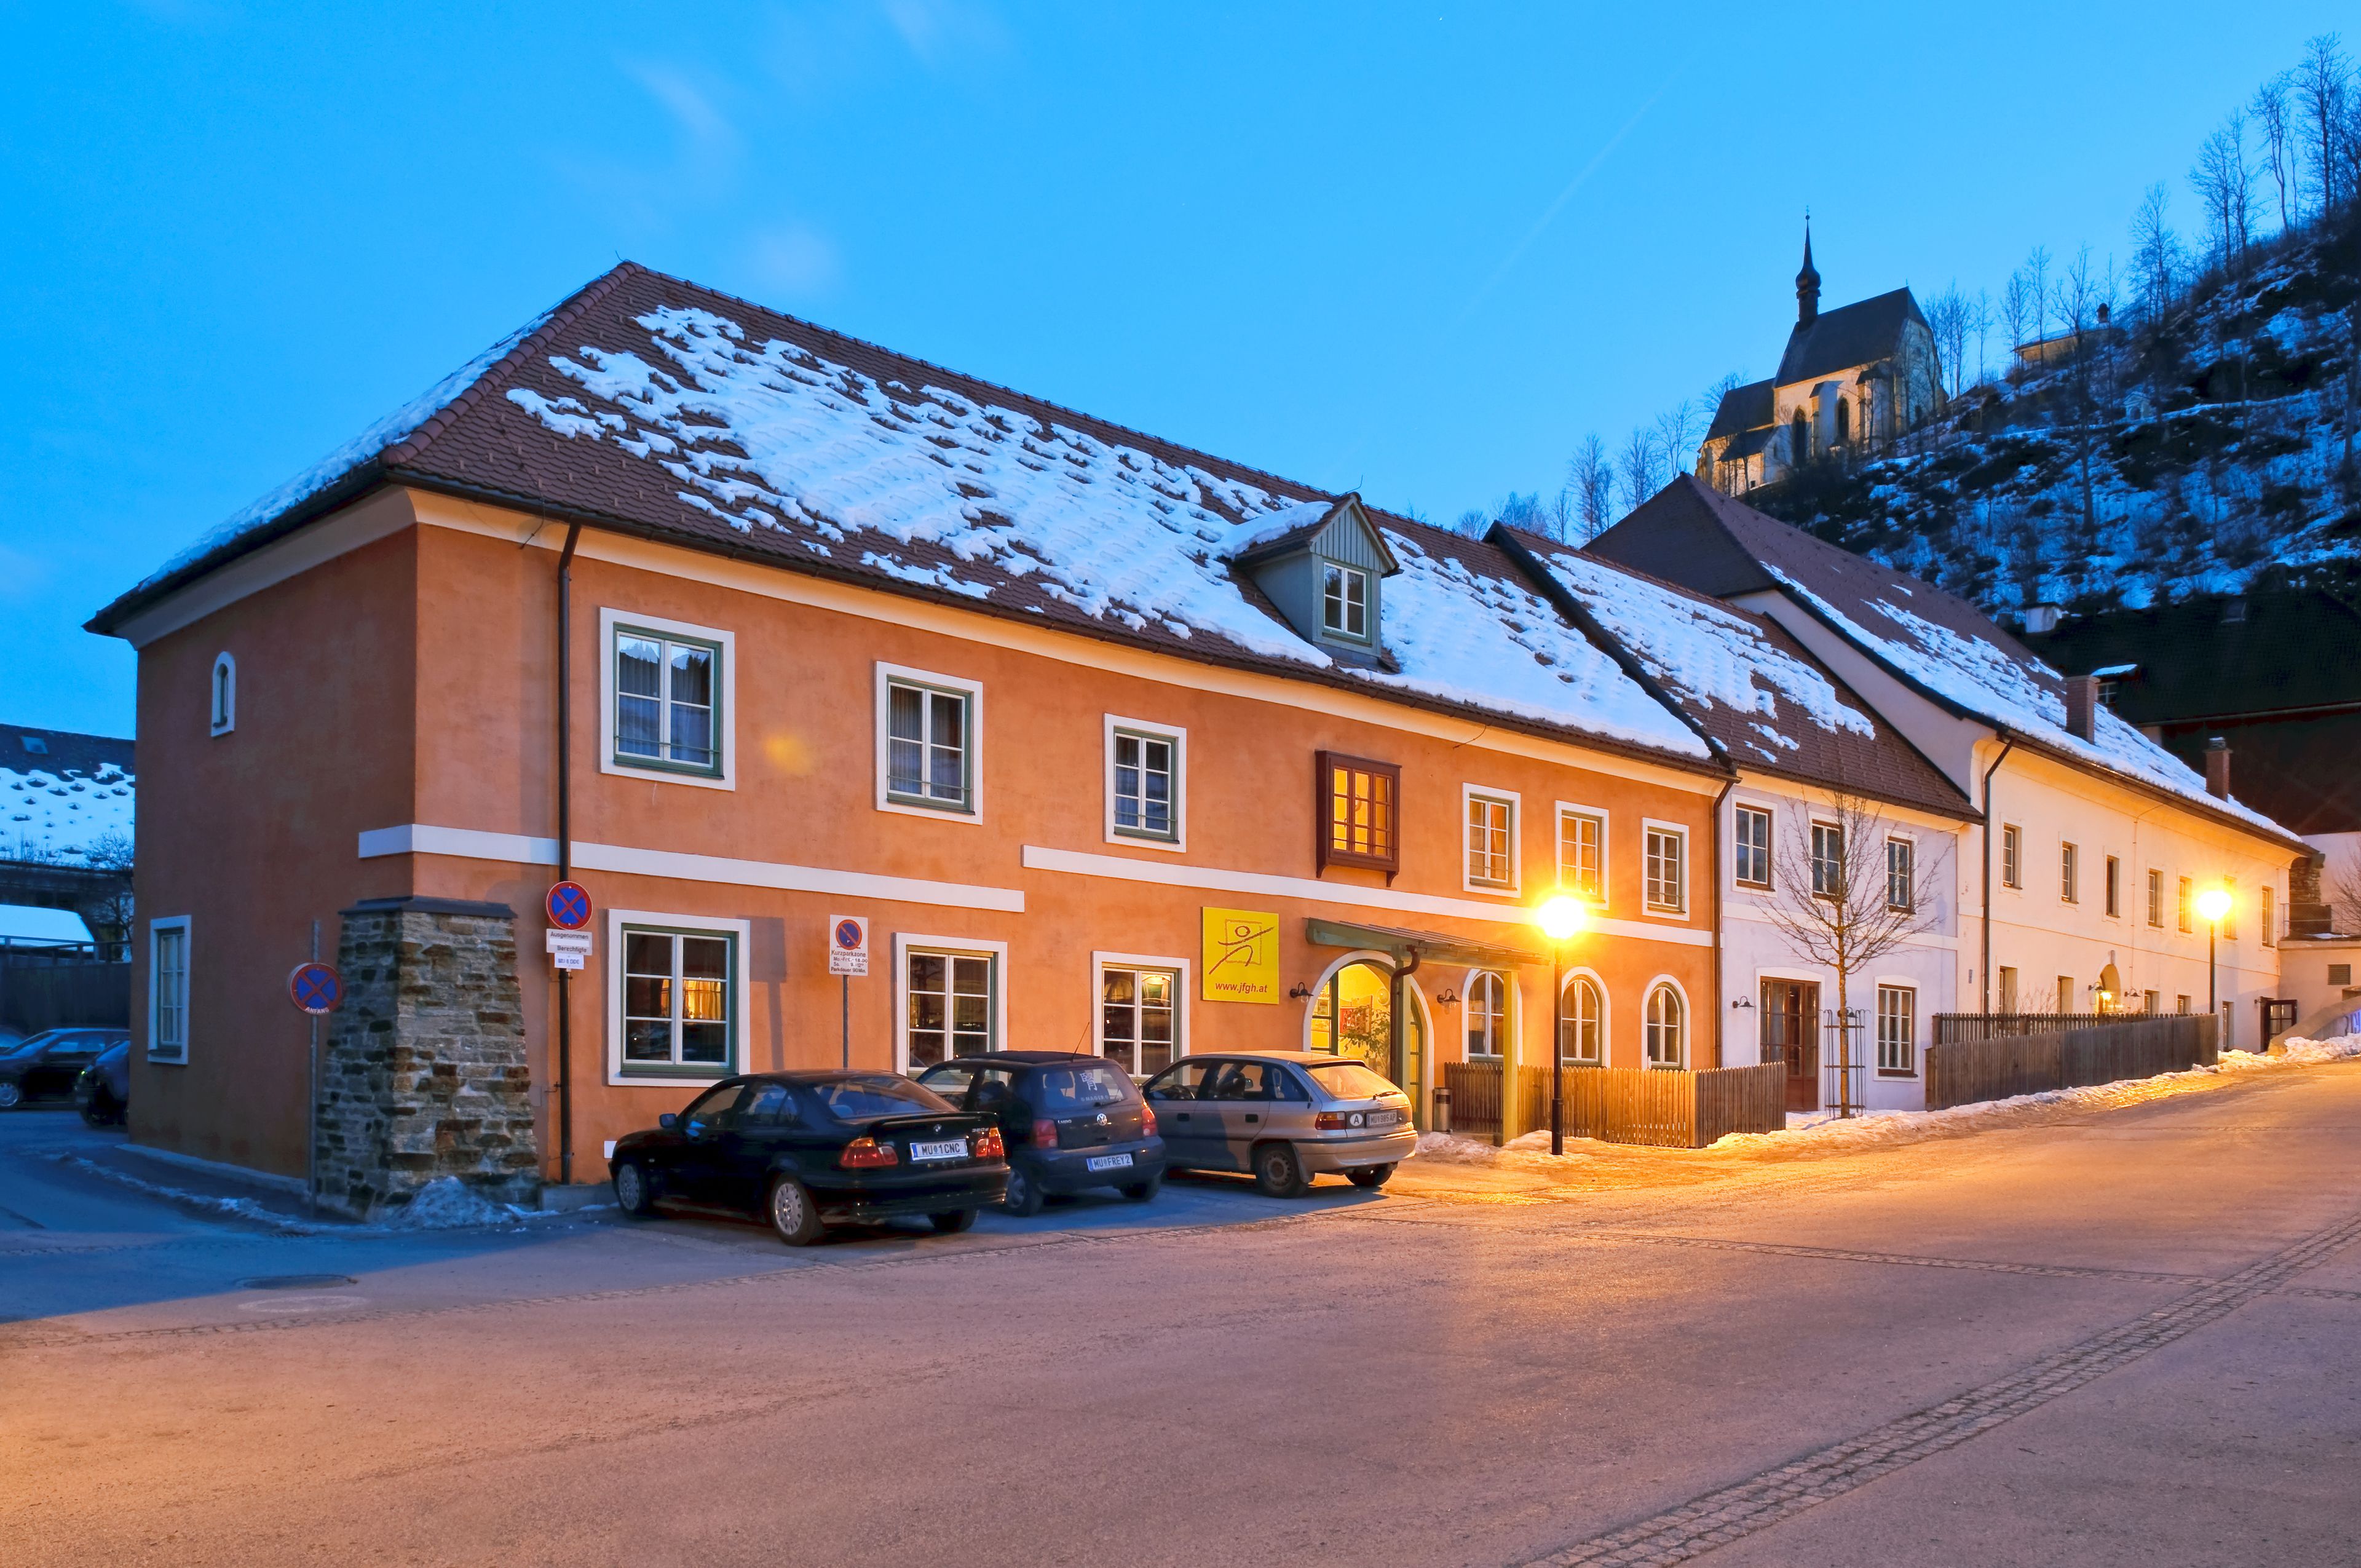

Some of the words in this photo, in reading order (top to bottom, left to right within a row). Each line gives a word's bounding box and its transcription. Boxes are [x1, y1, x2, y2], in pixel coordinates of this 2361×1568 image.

[1215, 982, 1268, 994] www.jfgh.at
[1354, 1115, 1359, 1124] A
[922, 1145, 933, 1155] MU
[1093, 1158, 1104, 1168] MU
